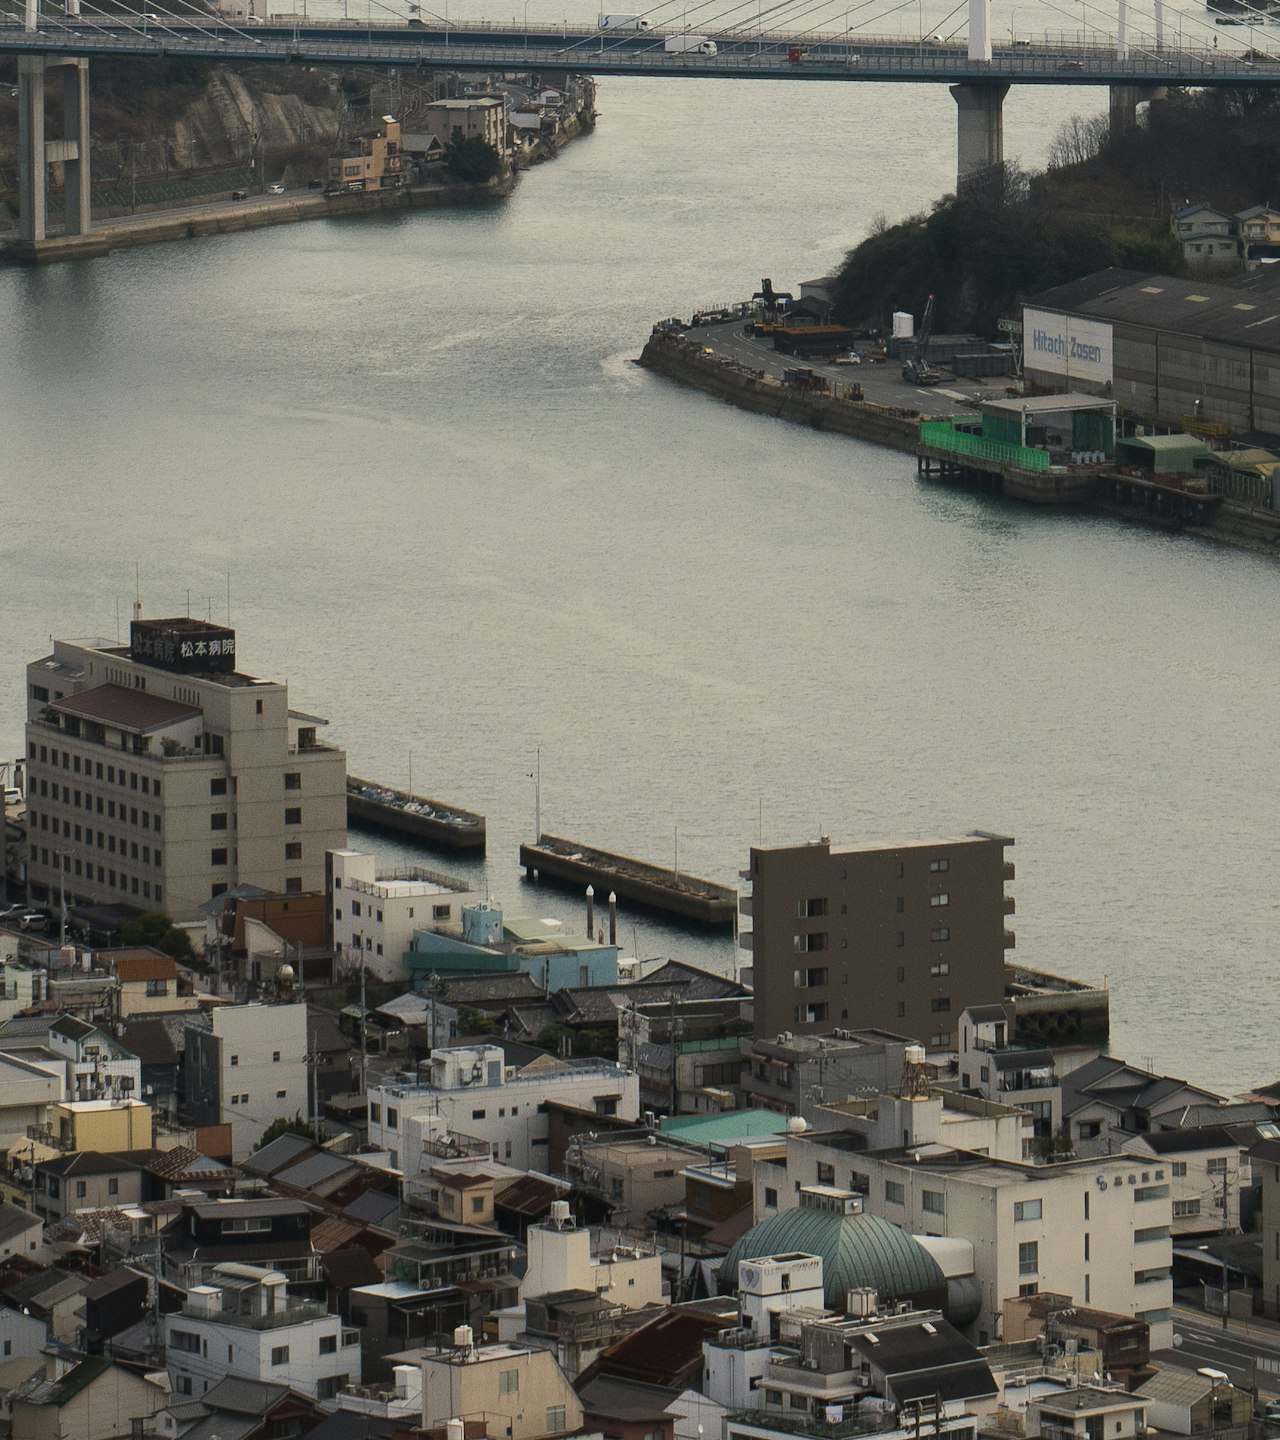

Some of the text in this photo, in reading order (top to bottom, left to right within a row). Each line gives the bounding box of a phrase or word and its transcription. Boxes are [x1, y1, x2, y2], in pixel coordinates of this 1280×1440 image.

[1033, 328, 1101, 363] Hitach Zosen
[181, 639, 235, 658] 松本病院
